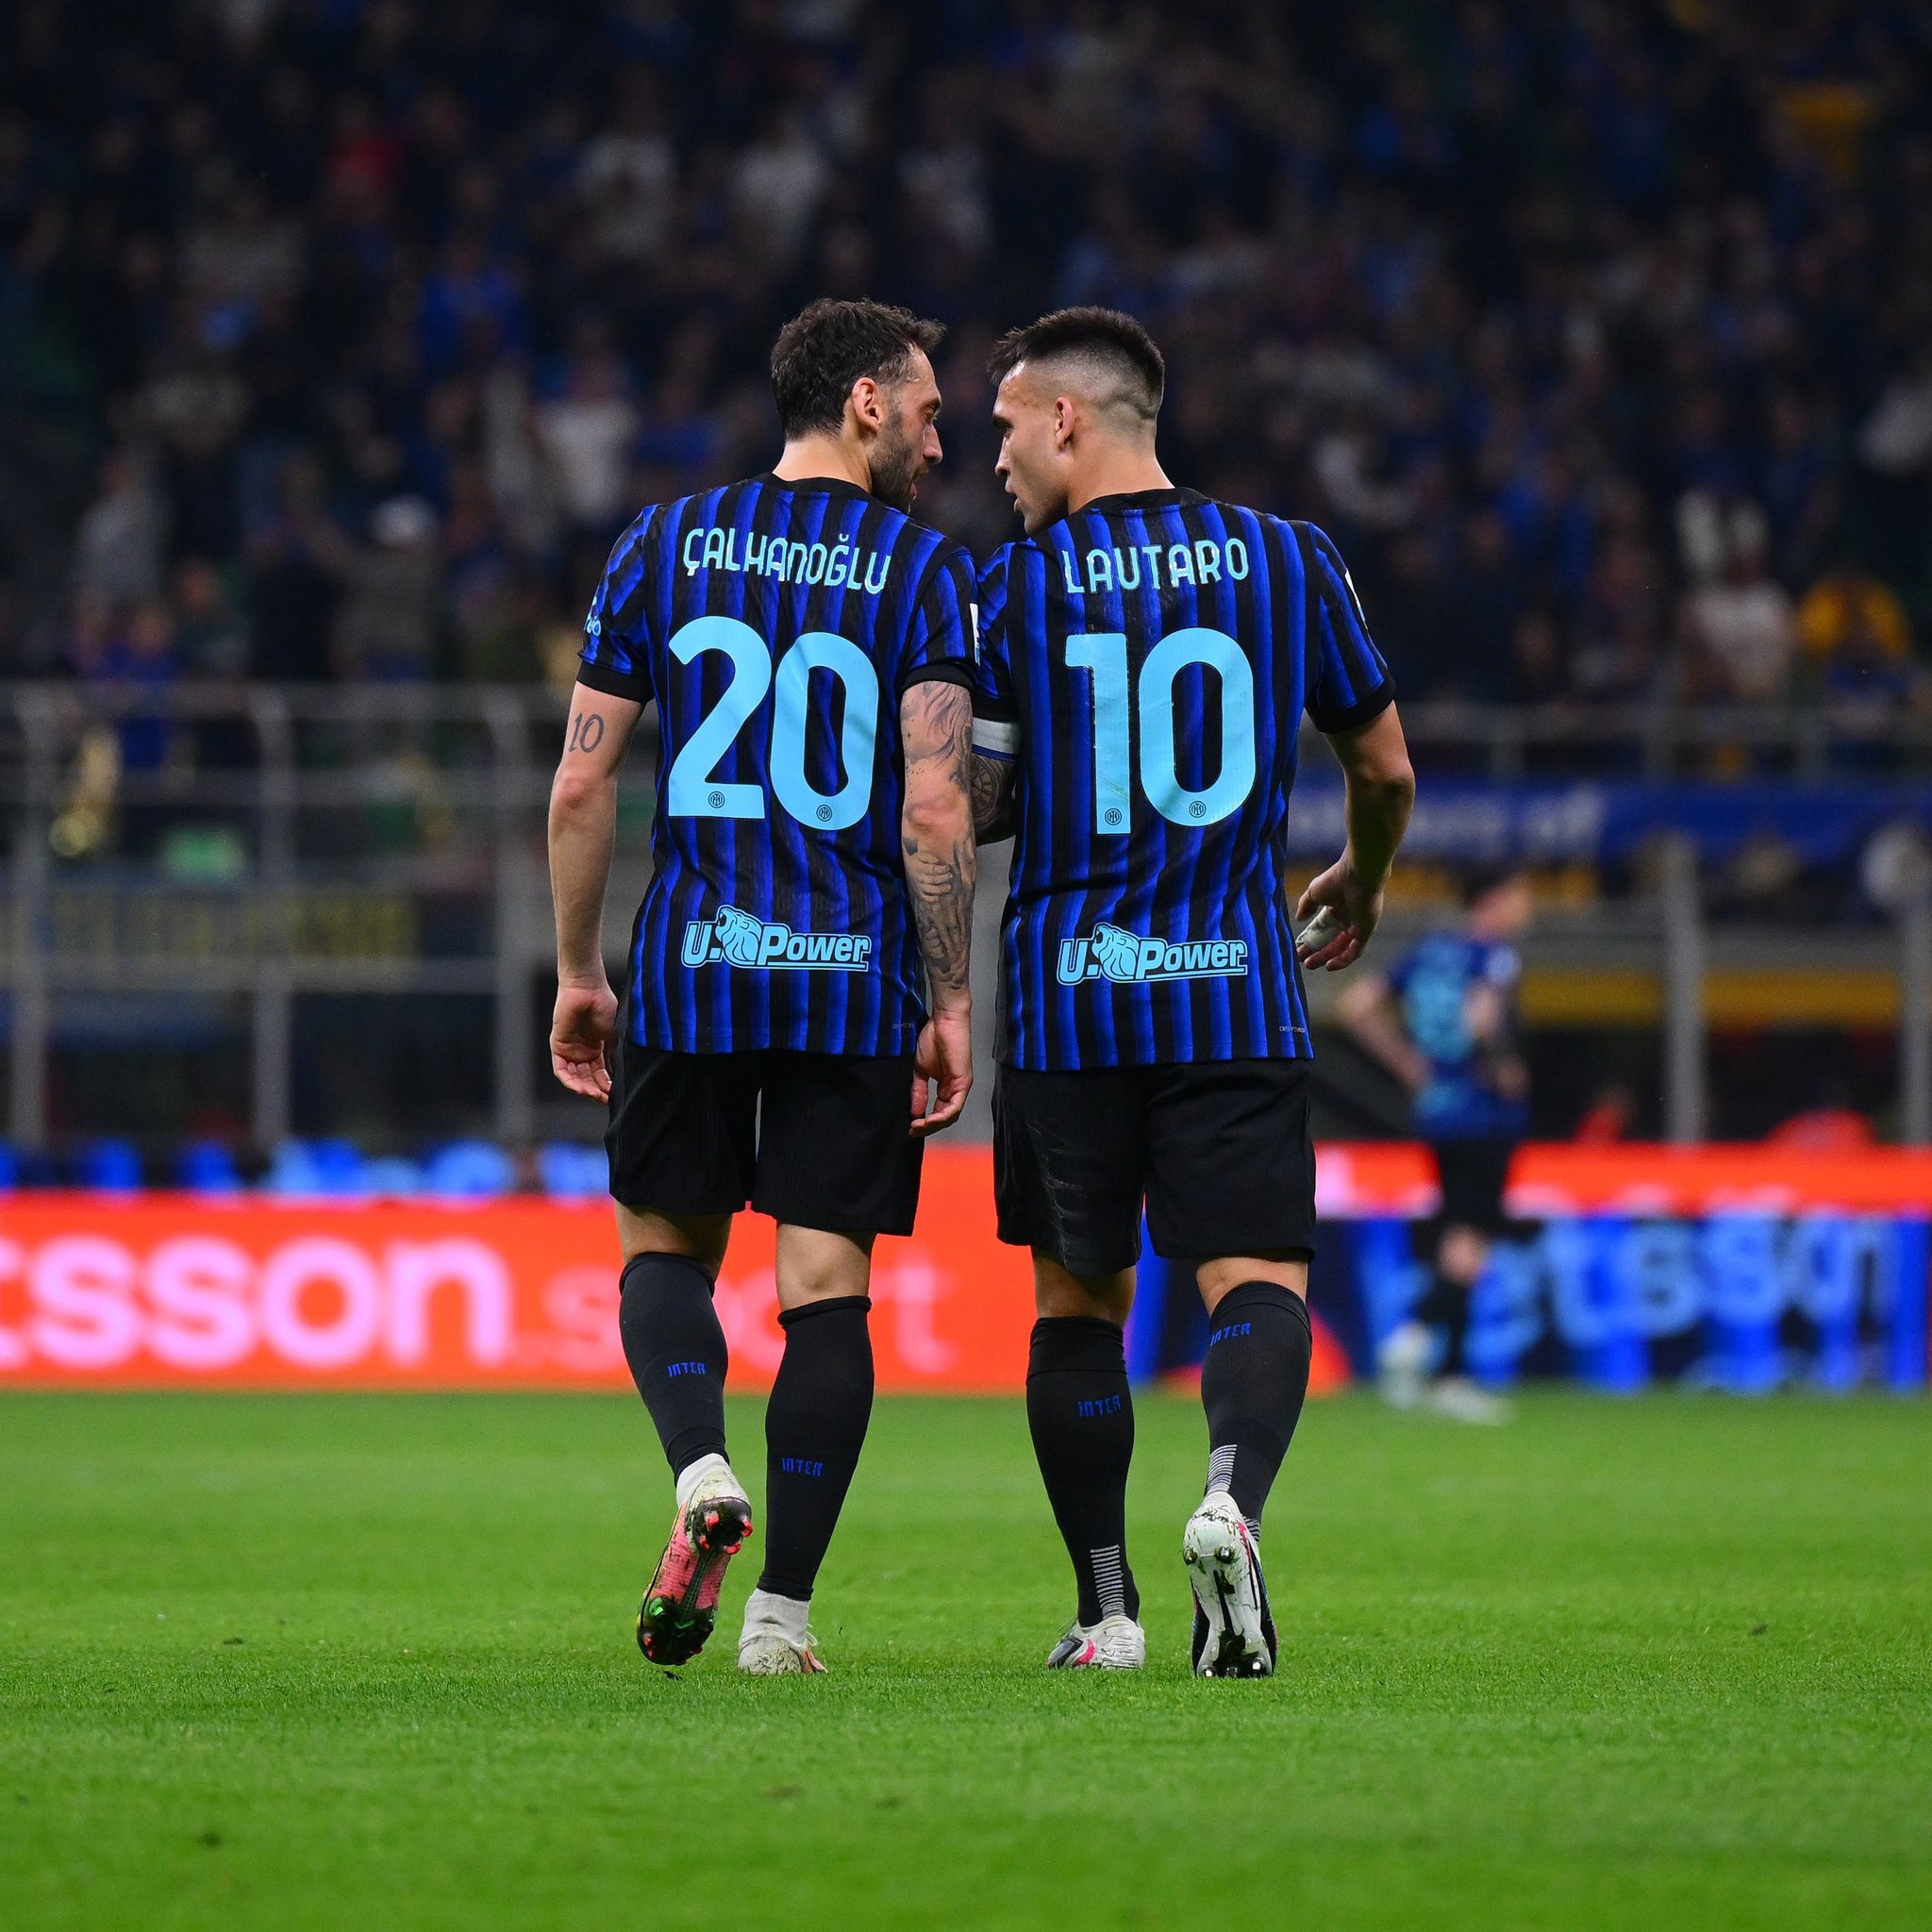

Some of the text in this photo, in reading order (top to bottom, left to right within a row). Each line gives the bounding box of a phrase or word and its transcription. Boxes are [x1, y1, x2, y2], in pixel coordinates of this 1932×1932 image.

[683, 527, 891, 594] ÇALHANOĞLU
[1061, 538, 1249, 593] LAUTARO
[568, 713, 605, 753] 10
[668, 616, 879, 831] 20
[1065, 627, 1257, 835] 10
[1209, 1323, 1252, 1346] INTER
[667, 1361, 707, 1377] INTER
[1078, 1394, 1121, 1418] INTER
[781, 1457, 823, 1476] INTER
